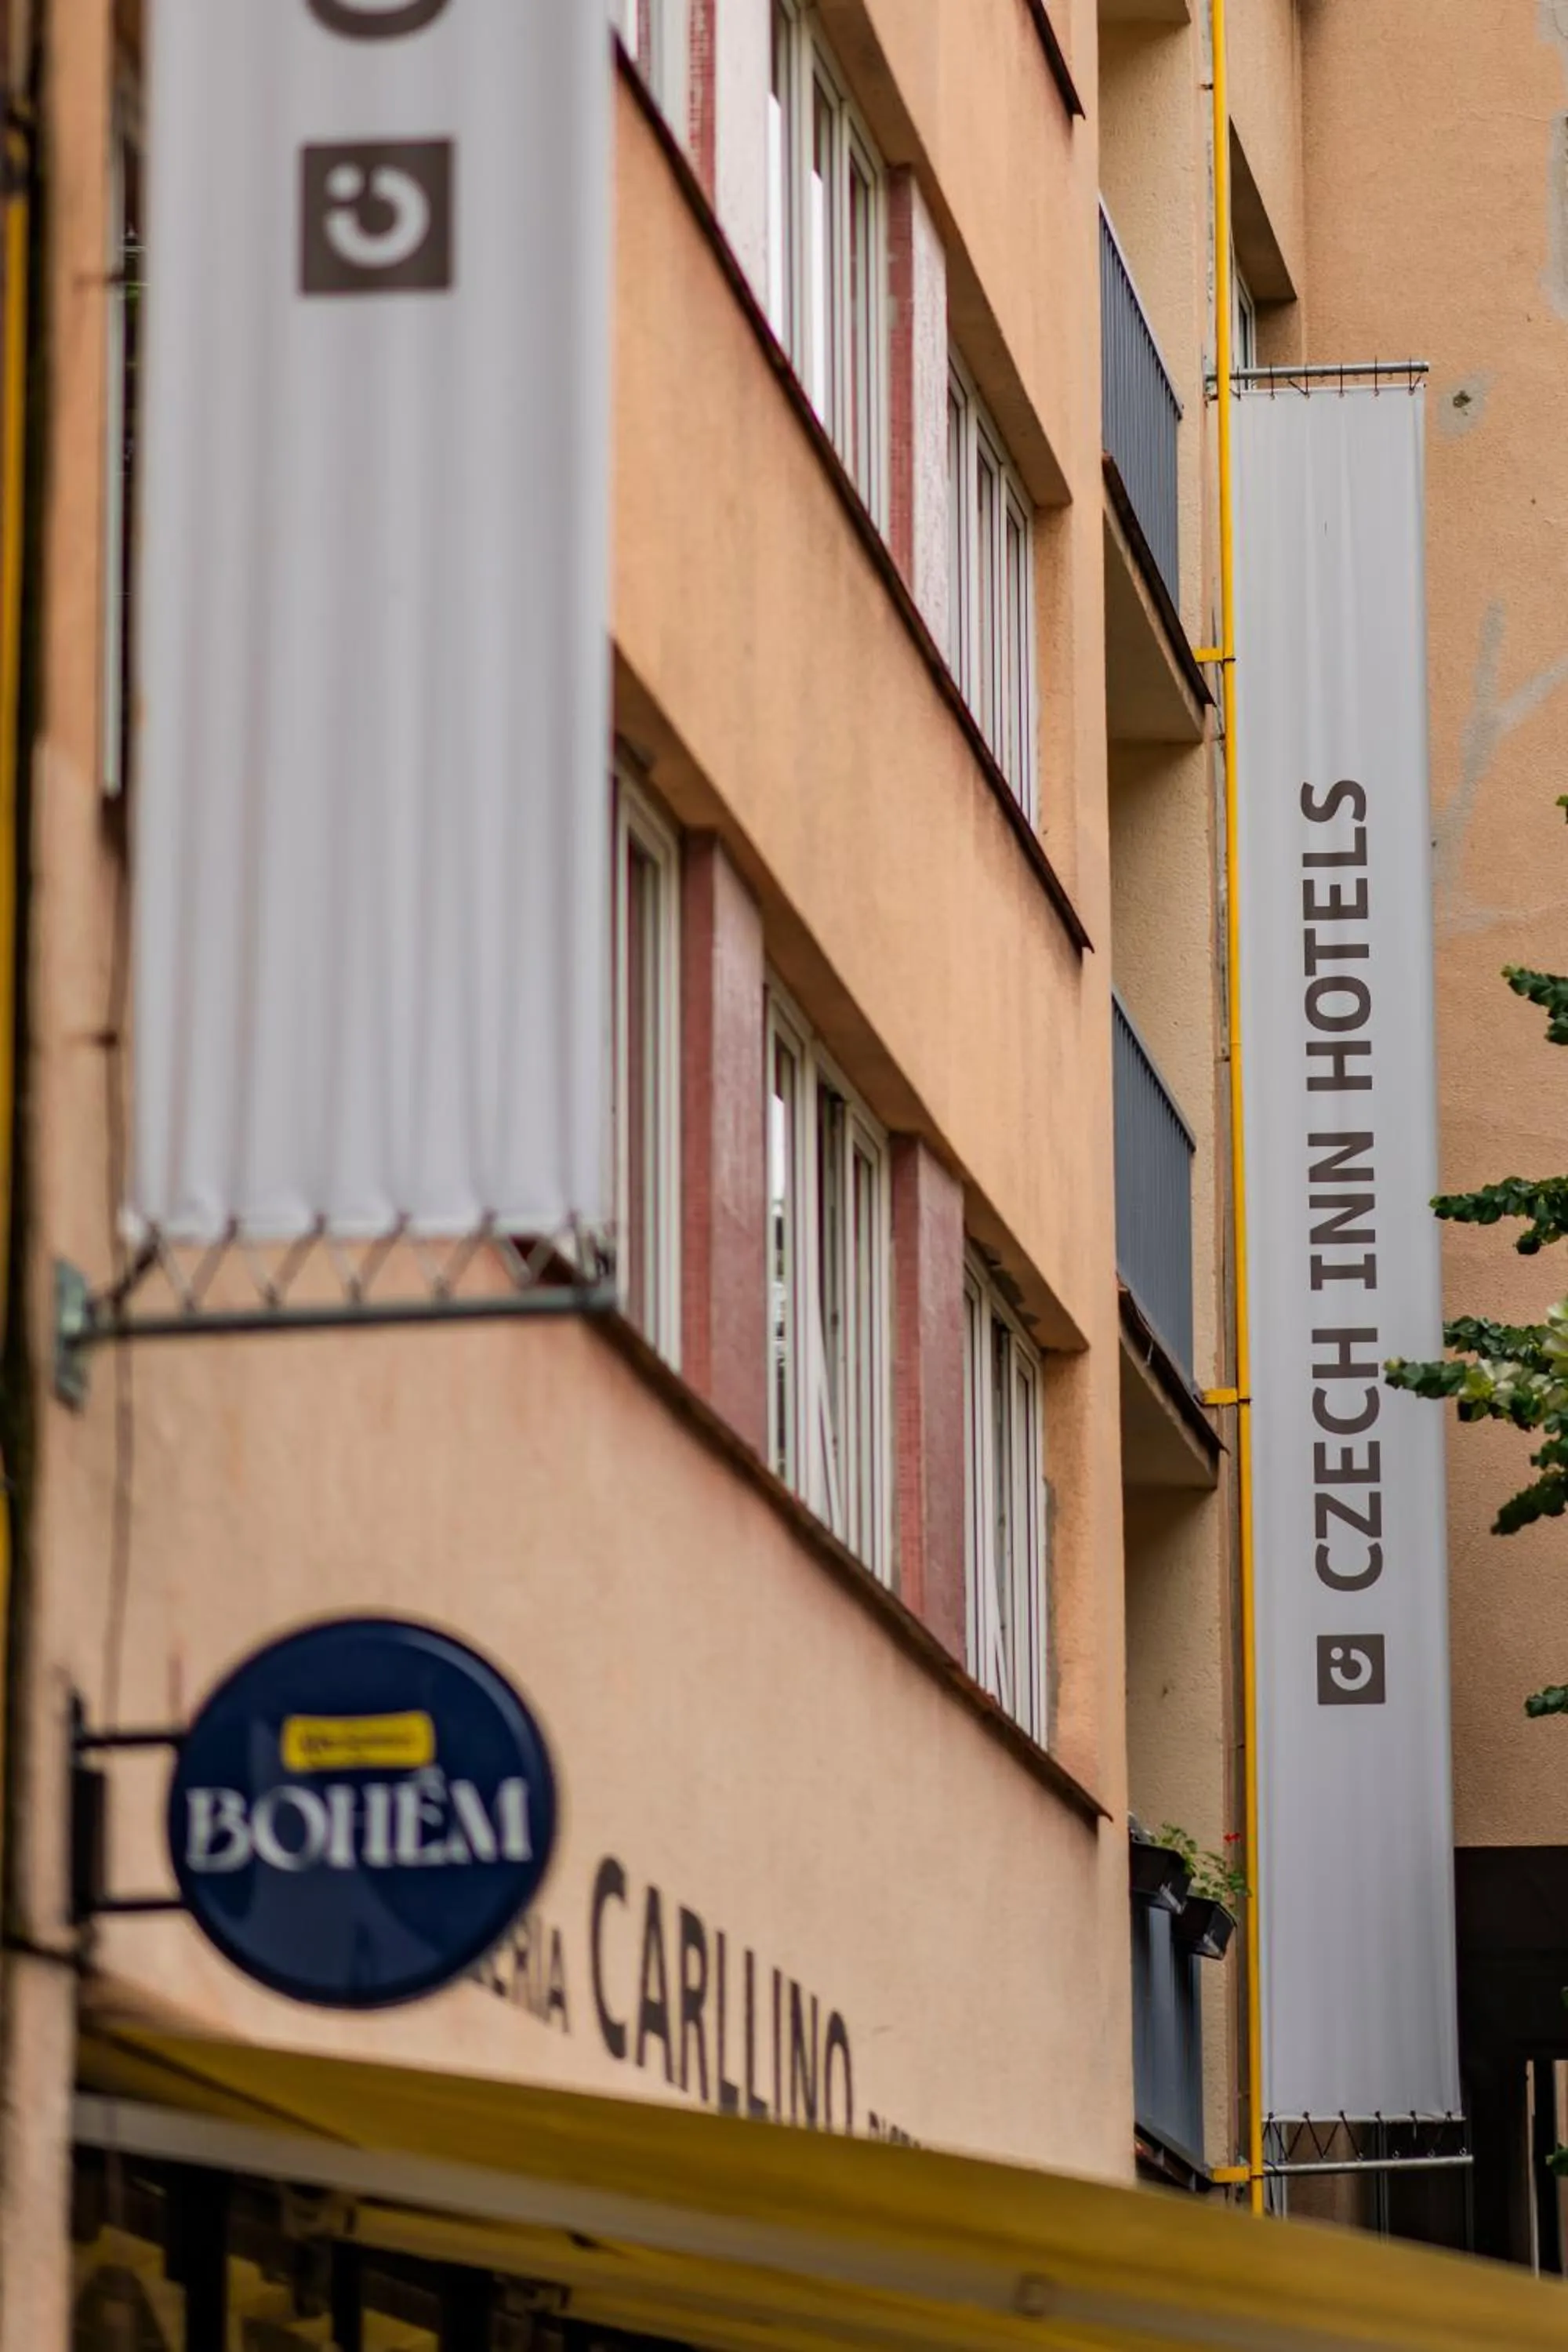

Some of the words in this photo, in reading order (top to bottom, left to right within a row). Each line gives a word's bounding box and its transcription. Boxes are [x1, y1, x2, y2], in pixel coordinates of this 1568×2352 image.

[1300, 779, 1372, 1091] HOTELS
[1308, 1131, 1377, 1290] INN
[1312, 1327, 1384, 1592] CZECH
